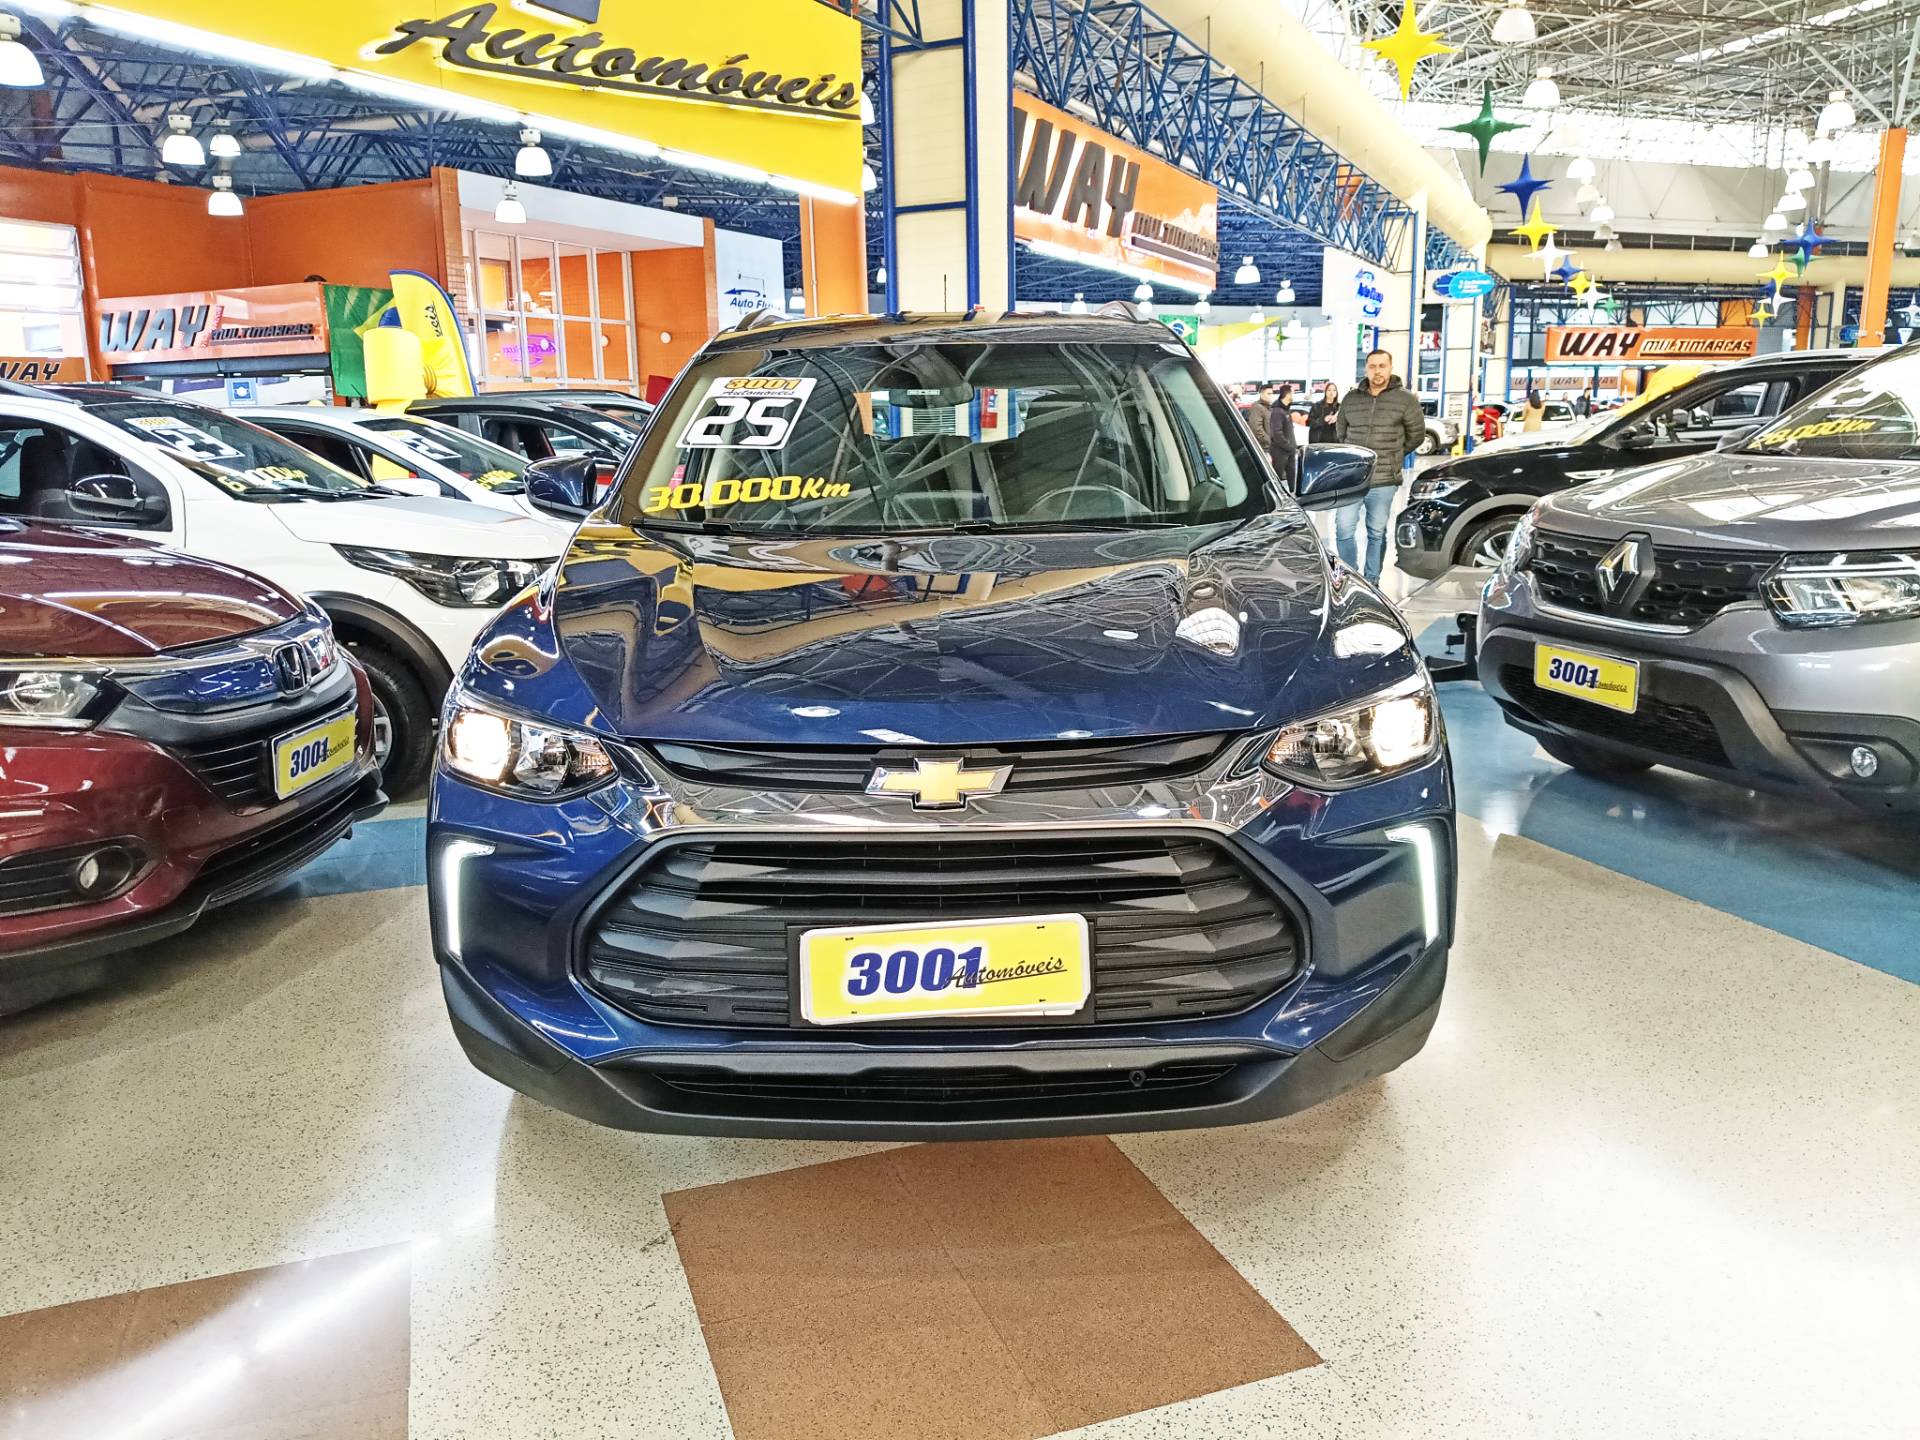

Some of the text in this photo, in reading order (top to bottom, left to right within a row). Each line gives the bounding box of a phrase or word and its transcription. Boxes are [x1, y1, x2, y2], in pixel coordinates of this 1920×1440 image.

[376, 2, 859, 110] Automóveis
[1014, 106, 1140, 238] WAY
[730, 296, 753, 309] Auto
[101, 304, 210, 352] WAY
[1558, 332, 1753, 357] WAY MULTIMARCAS
[724, 378, 802, 391] 3001
[1514, 377, 1541, 386] WY
[686, 397, 795, 446] 25
[642, 475, 851, 513] 30.000Km
[1549, 657, 1600, 689] 3001
[290, 736, 329, 778] 3001
[847, 946, 983, 997] 3001
[942, 956, 1066, 989] Automóveis
